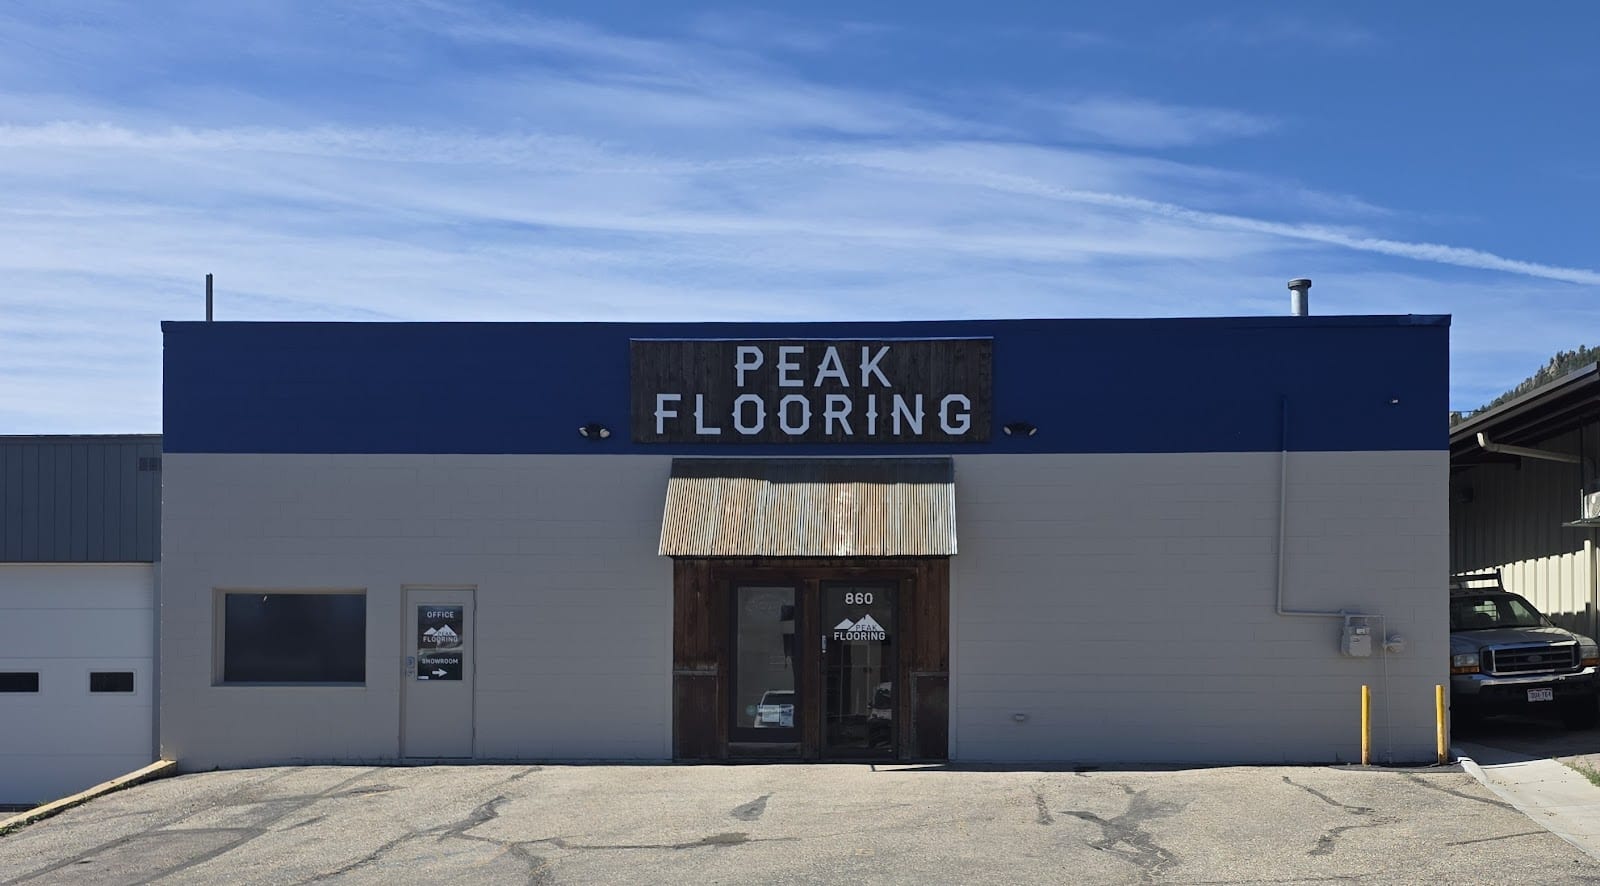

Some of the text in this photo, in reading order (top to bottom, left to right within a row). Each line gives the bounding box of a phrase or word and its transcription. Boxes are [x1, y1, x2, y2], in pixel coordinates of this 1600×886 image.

[734, 345, 892, 388] PEAK
[653, 393, 972, 436] FLOORING
[845, 592, 873, 605] 860
[833, 631, 886, 640] FLOORING
